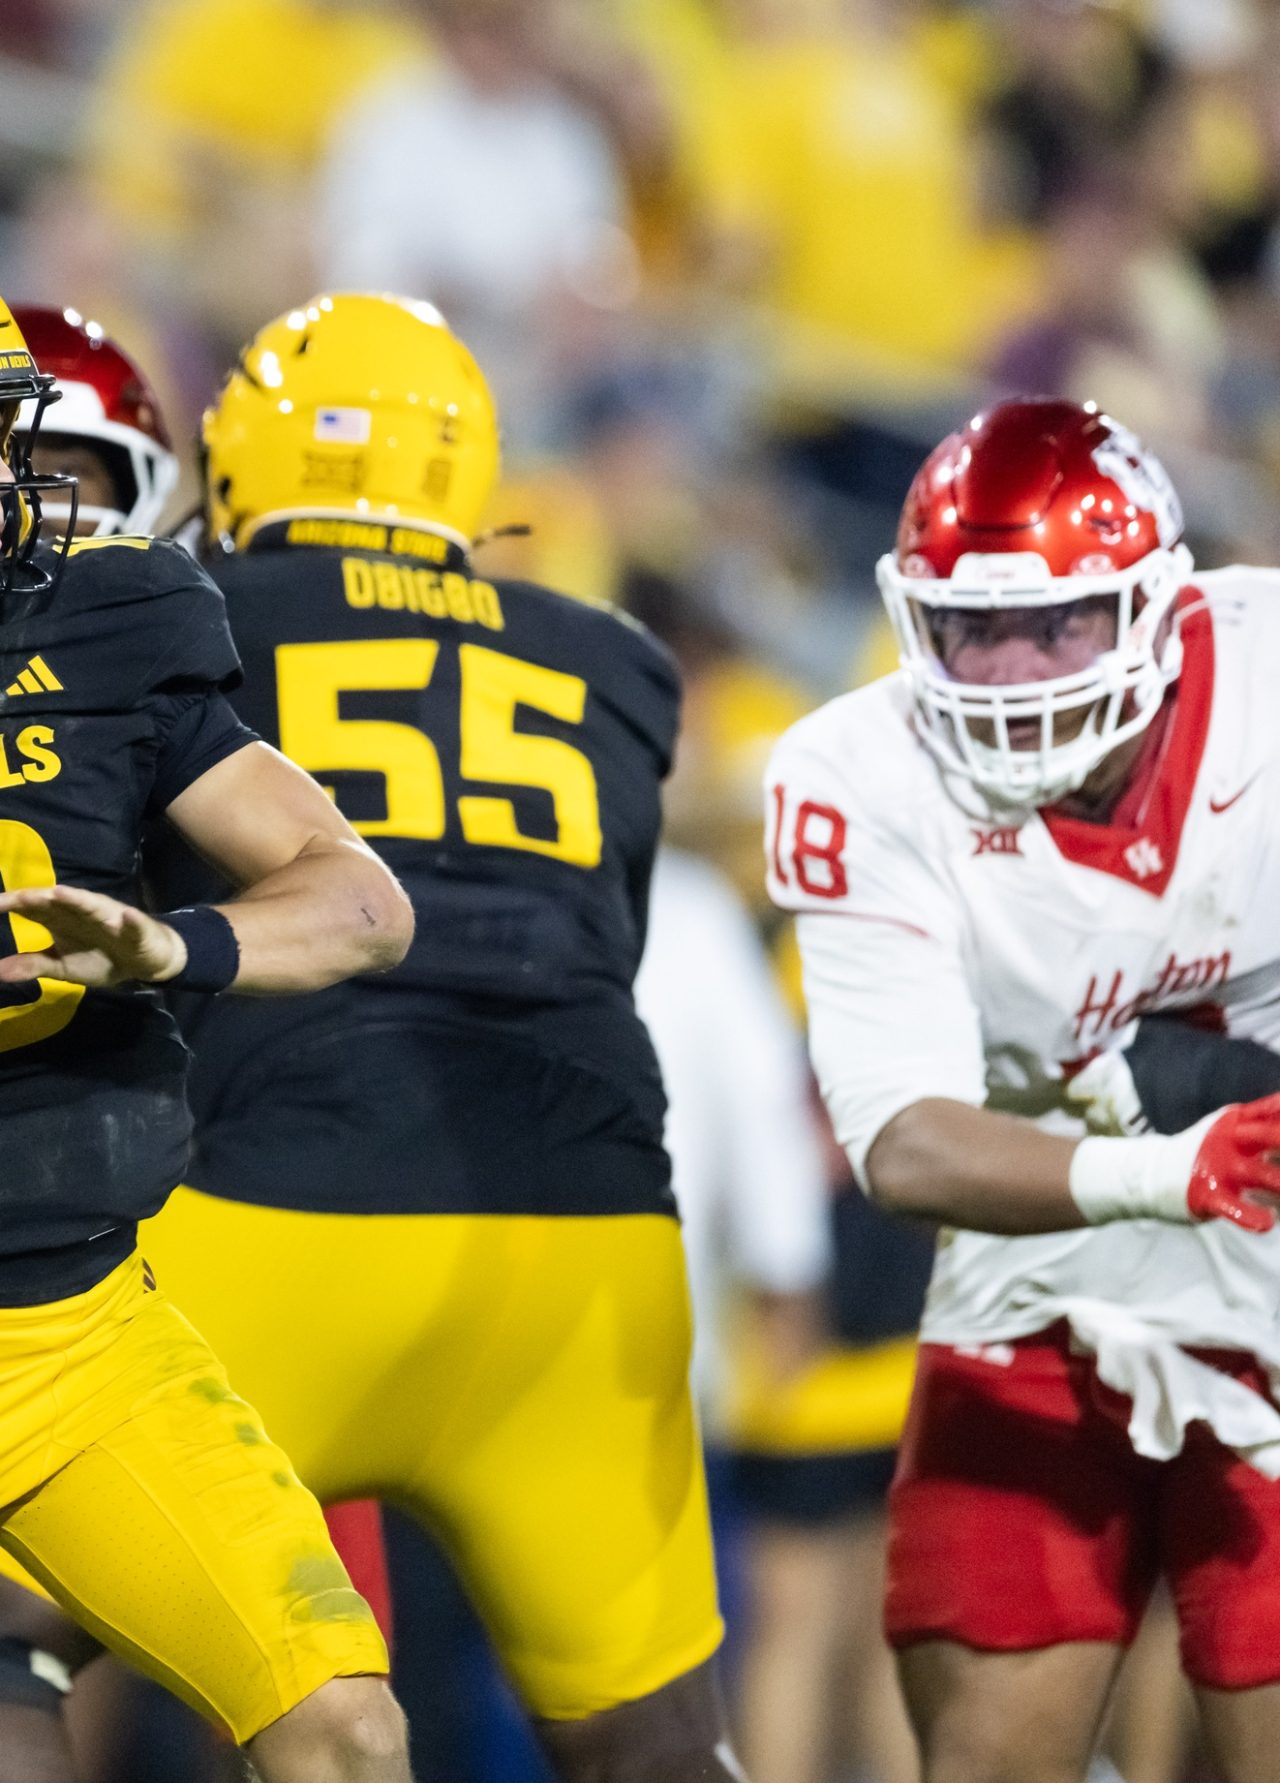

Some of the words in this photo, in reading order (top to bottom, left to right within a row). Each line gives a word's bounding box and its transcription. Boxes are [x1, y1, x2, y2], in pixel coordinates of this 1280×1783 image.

[341, 557, 505, 631] OBIGBO
[275, 638, 602, 868] 55
[773, 784, 848, 899] 18
